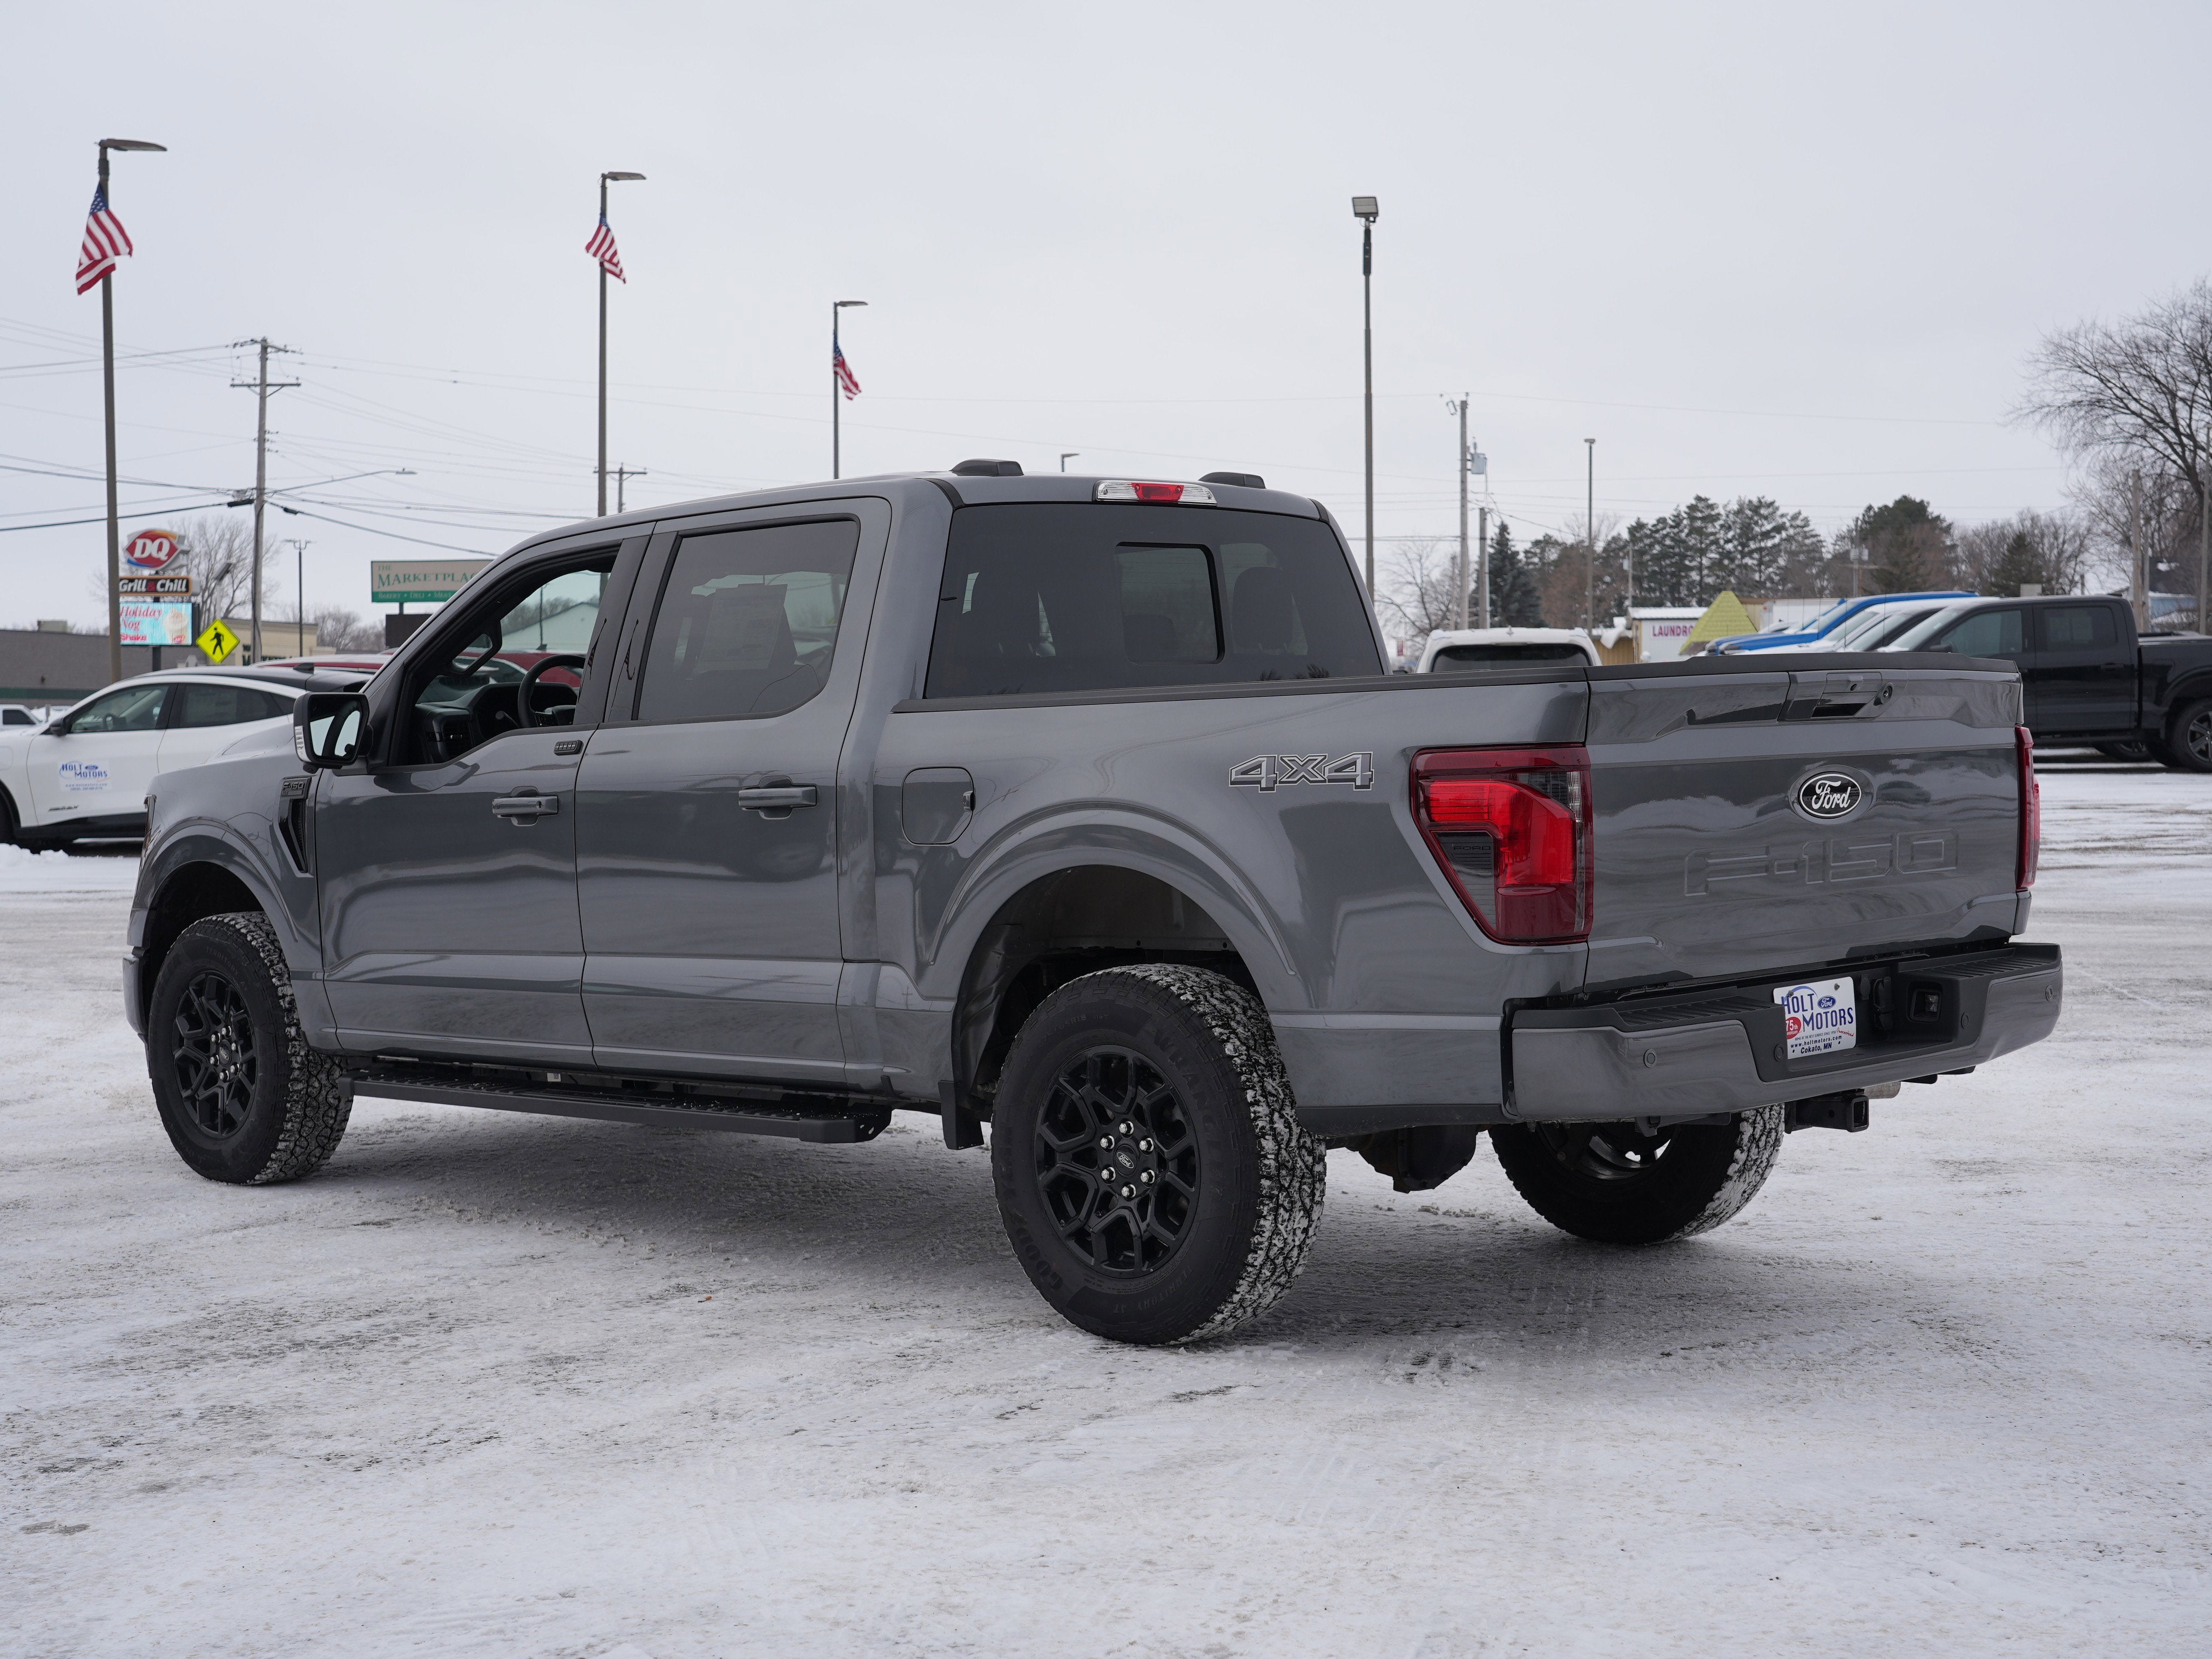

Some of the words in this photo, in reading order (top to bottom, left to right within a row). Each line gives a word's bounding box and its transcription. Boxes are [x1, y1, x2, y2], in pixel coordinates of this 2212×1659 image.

[133, 537, 170, 561] DQ
[119, 579, 147, 592] Grill
[147, 581, 156, 592] &
[157, 579, 187, 592] Chill
[120, 606, 161, 620] Holiday
[121, 619, 140, 631] Nog
[120, 633, 147, 642] Shake
[62, 763, 82, 771] HOLT
[75, 770, 107, 778] MOTORS
[283, 781, 306, 790] F-150
[1811, 780, 1851, 810] Ford
[1684, 828, 1959, 896] F-150
[1781, 993, 1815, 1015] HOLT
[1821, 997, 1833, 1008] Ford
[1785, 1020, 1798, 1032] 75th
[1802, 1007, 1854, 1033] MOTORS
[1836, 1027, 1854, 1037] Guaranteed
[1791, 1035, 1842, 1048] www.holtmotors.com
[1800, 1044, 1822, 1054] Cokato,
[1823, 1042, 1832, 1050] MN
[1119, 1154, 1131, 1166] Ford
[1137, 1265, 1193, 1311] TERRITORY
